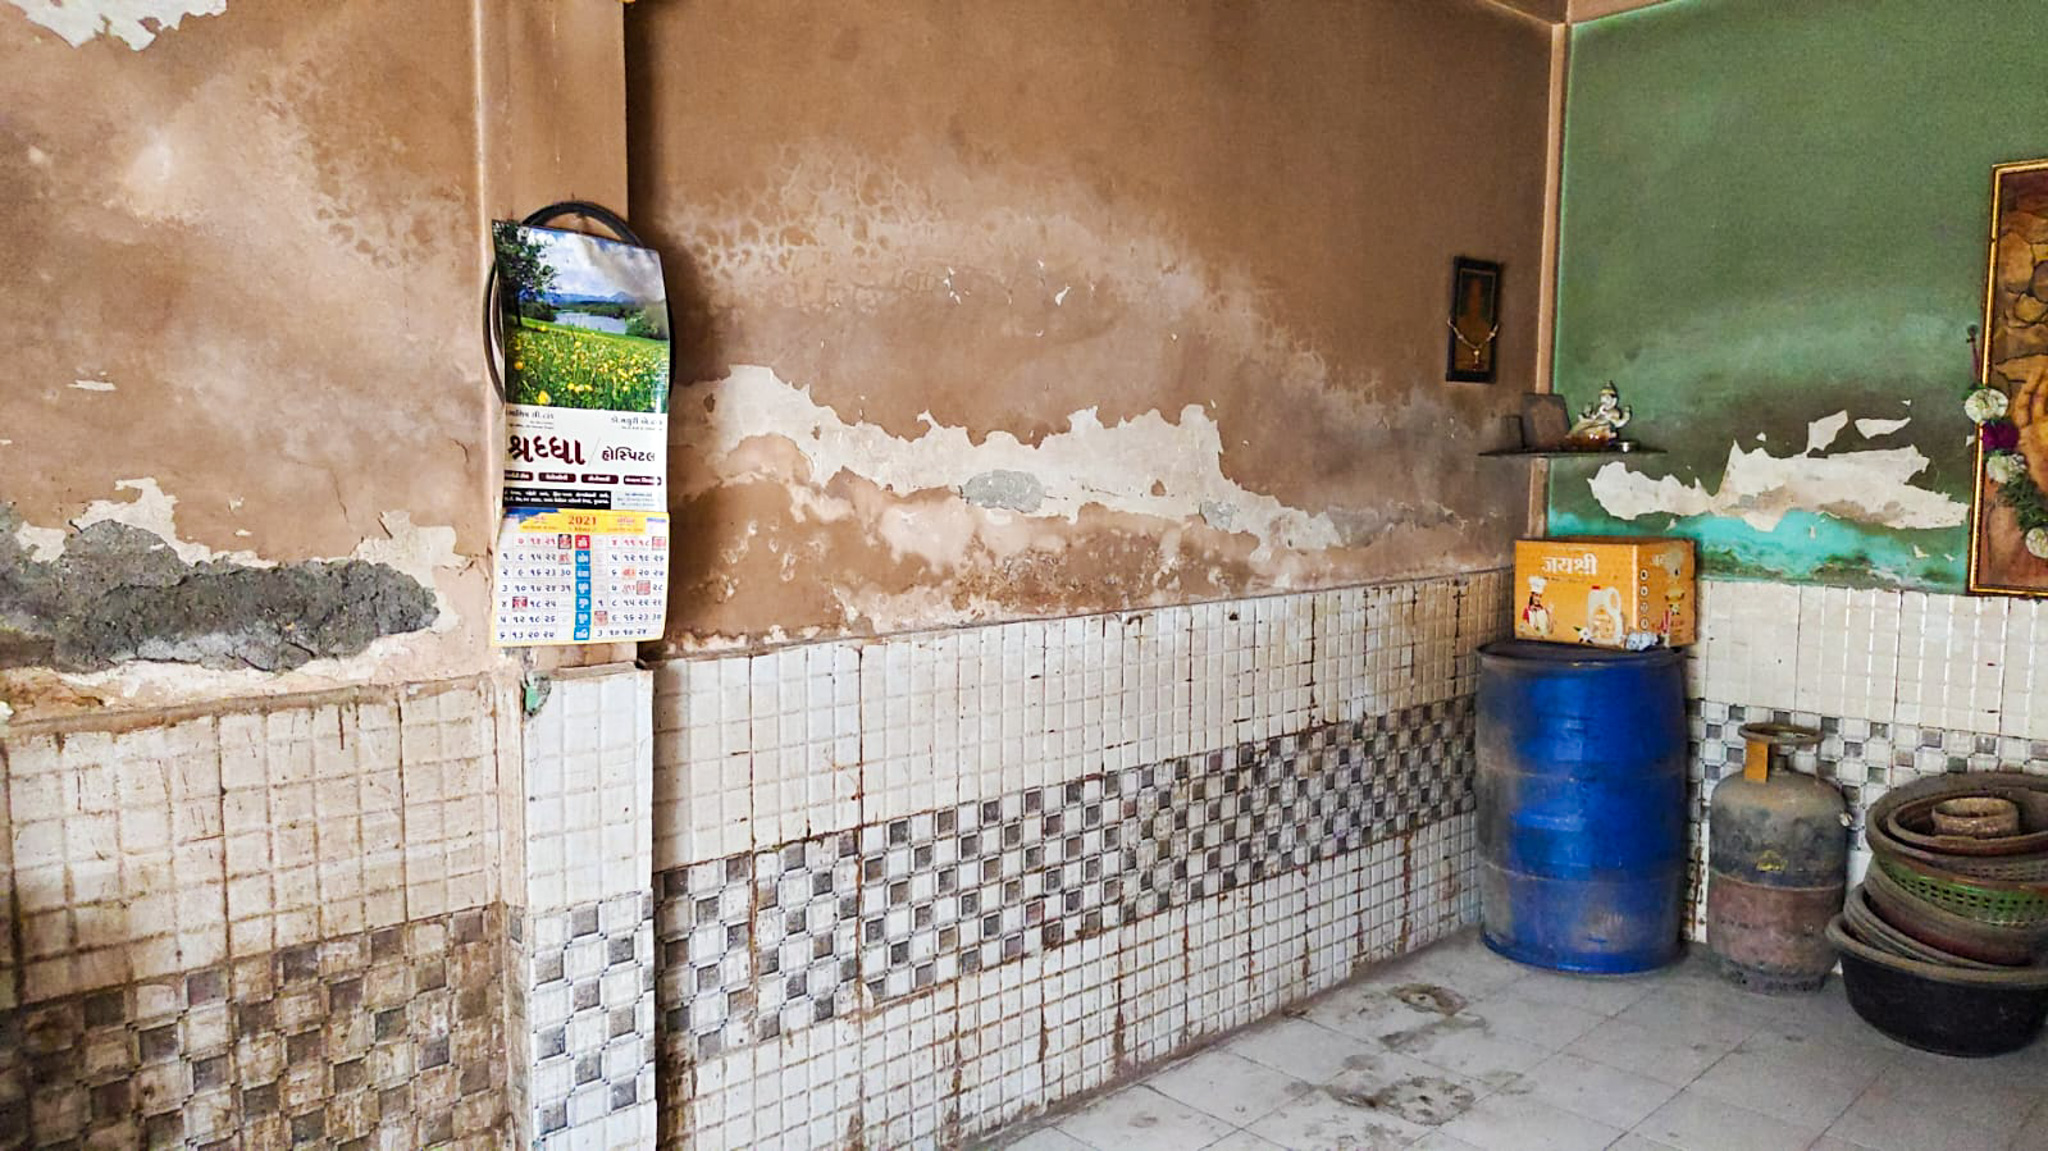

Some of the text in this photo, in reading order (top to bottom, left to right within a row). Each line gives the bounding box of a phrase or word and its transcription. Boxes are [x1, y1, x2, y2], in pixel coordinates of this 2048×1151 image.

[602, 445, 655, 462] હોસ્પિટલ
[568, 516, 596, 525] 2021
[1541, 552, 1598, 576] जयश्री
